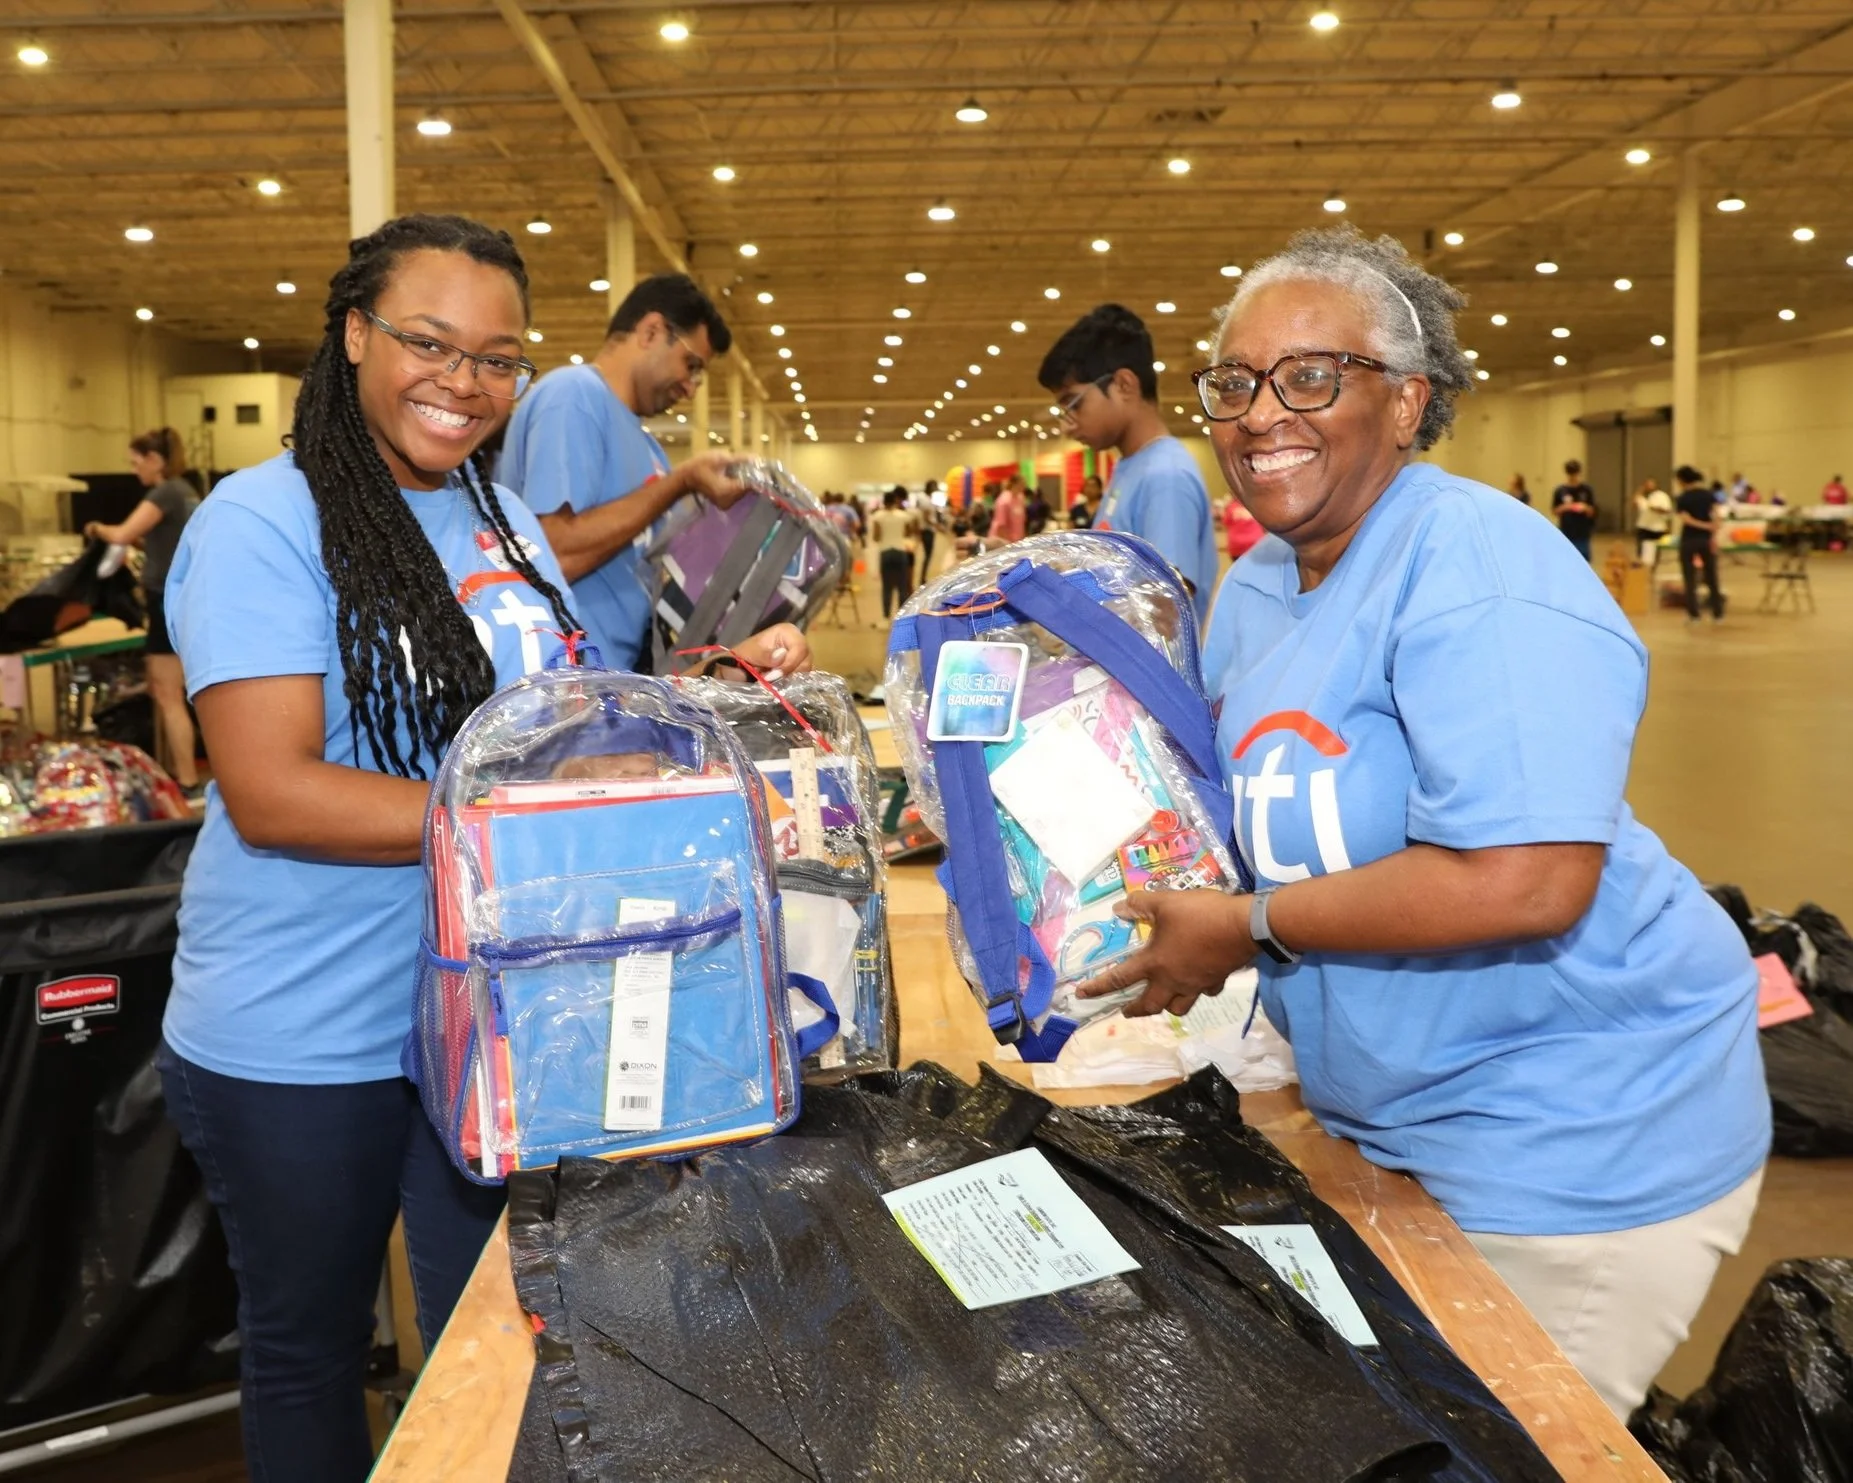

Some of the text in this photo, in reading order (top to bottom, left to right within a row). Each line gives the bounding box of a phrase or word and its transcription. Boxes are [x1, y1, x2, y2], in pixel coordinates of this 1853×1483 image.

[946, 673, 1011, 692] CLEAR
[948, 695, 1006, 707] BACKPACK
[44, 984, 112, 1002] Rubbermaid
[630, 1062, 657, 1071] DIXON
